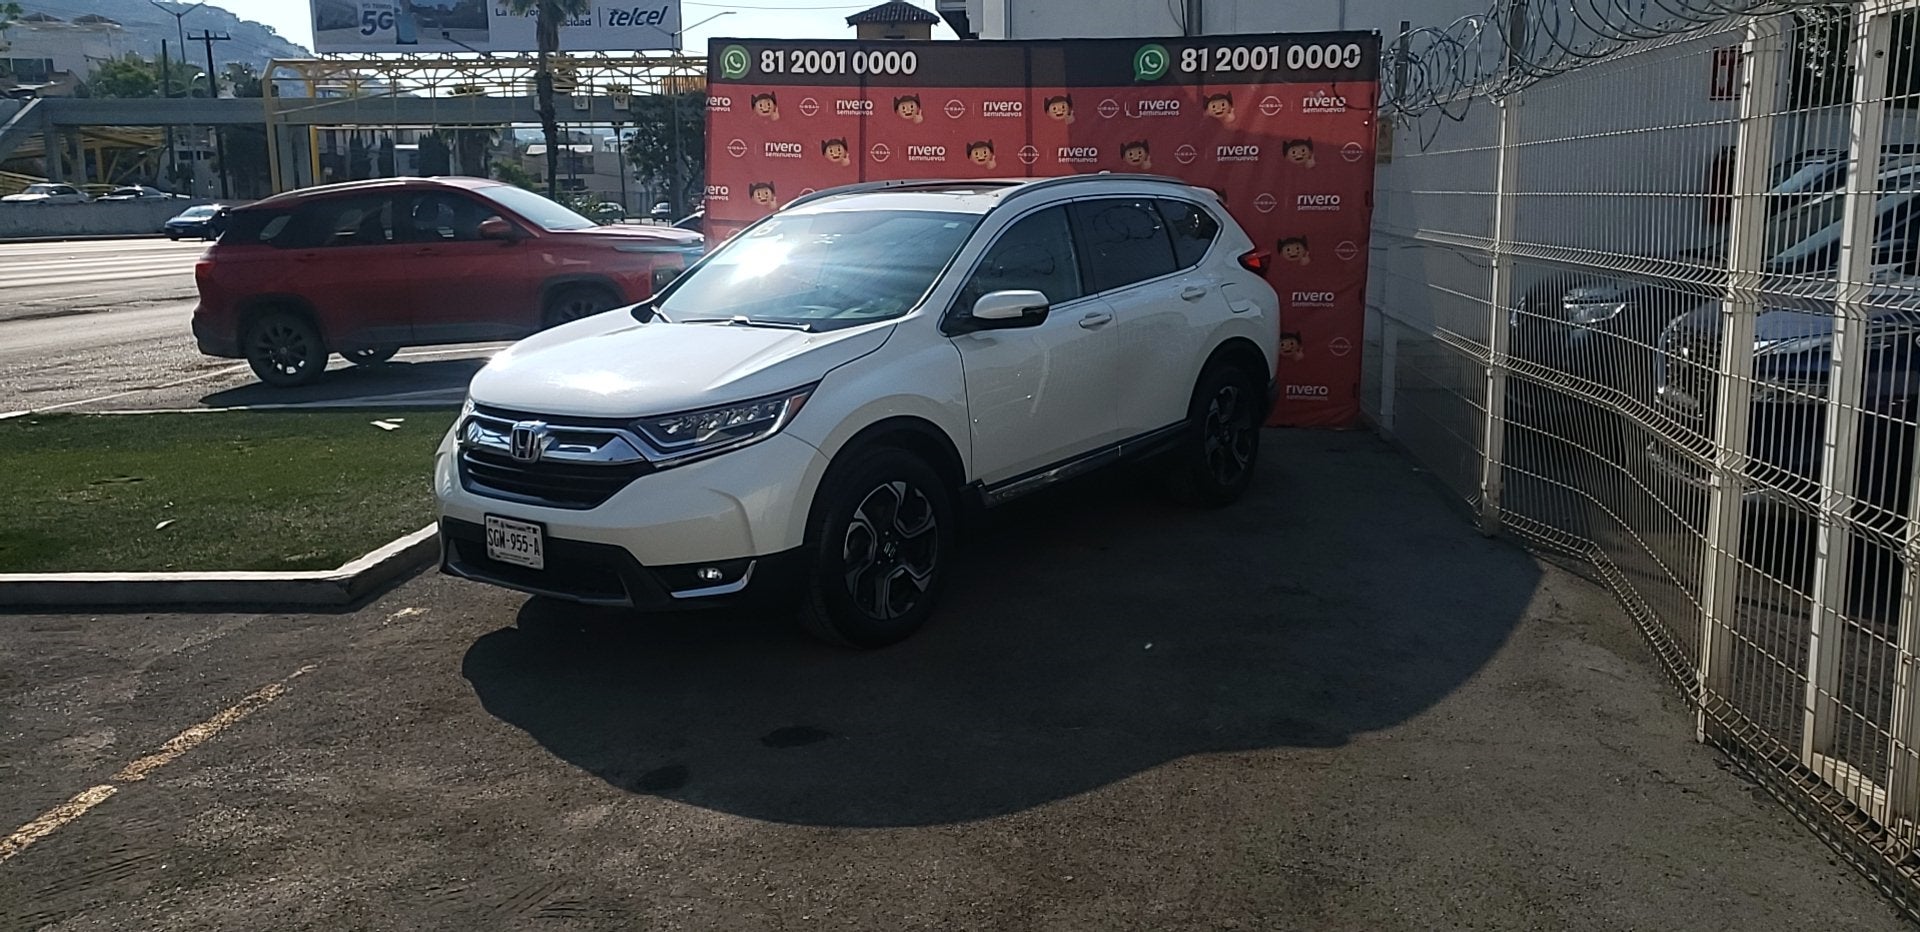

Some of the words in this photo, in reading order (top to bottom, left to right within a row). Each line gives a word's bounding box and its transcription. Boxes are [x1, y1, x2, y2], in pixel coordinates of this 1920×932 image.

[495, 8, 507, 16] La
[608, 6, 669, 26] telcel
[361, 10, 394, 35] 5G
[760, 50, 784, 73] 81
[790, 50, 845, 74] 2001
[852, 51, 917, 74] 0000
[1180, 48, 1208, 72] 81
[1215, 46, 1279, 71] 2001
[1287, 43, 1361, 69] 0000
[836, 99, 873, 110] rivero
[983, 101, 1022, 111] rivero
[1138, 99, 1180, 110] rivero
[1302, 96, 1346, 107] rivero
[765, 142, 802, 152] rivero
[908, 145, 946, 155] rivero
[1058, 147, 1098, 157] rivero
[1217, 145, 1259, 155] rivero
[1297, 194, 1340, 205] rivero
[1292, 291, 1335, 302] rivero
[1286, 384, 1328, 395] rivero
